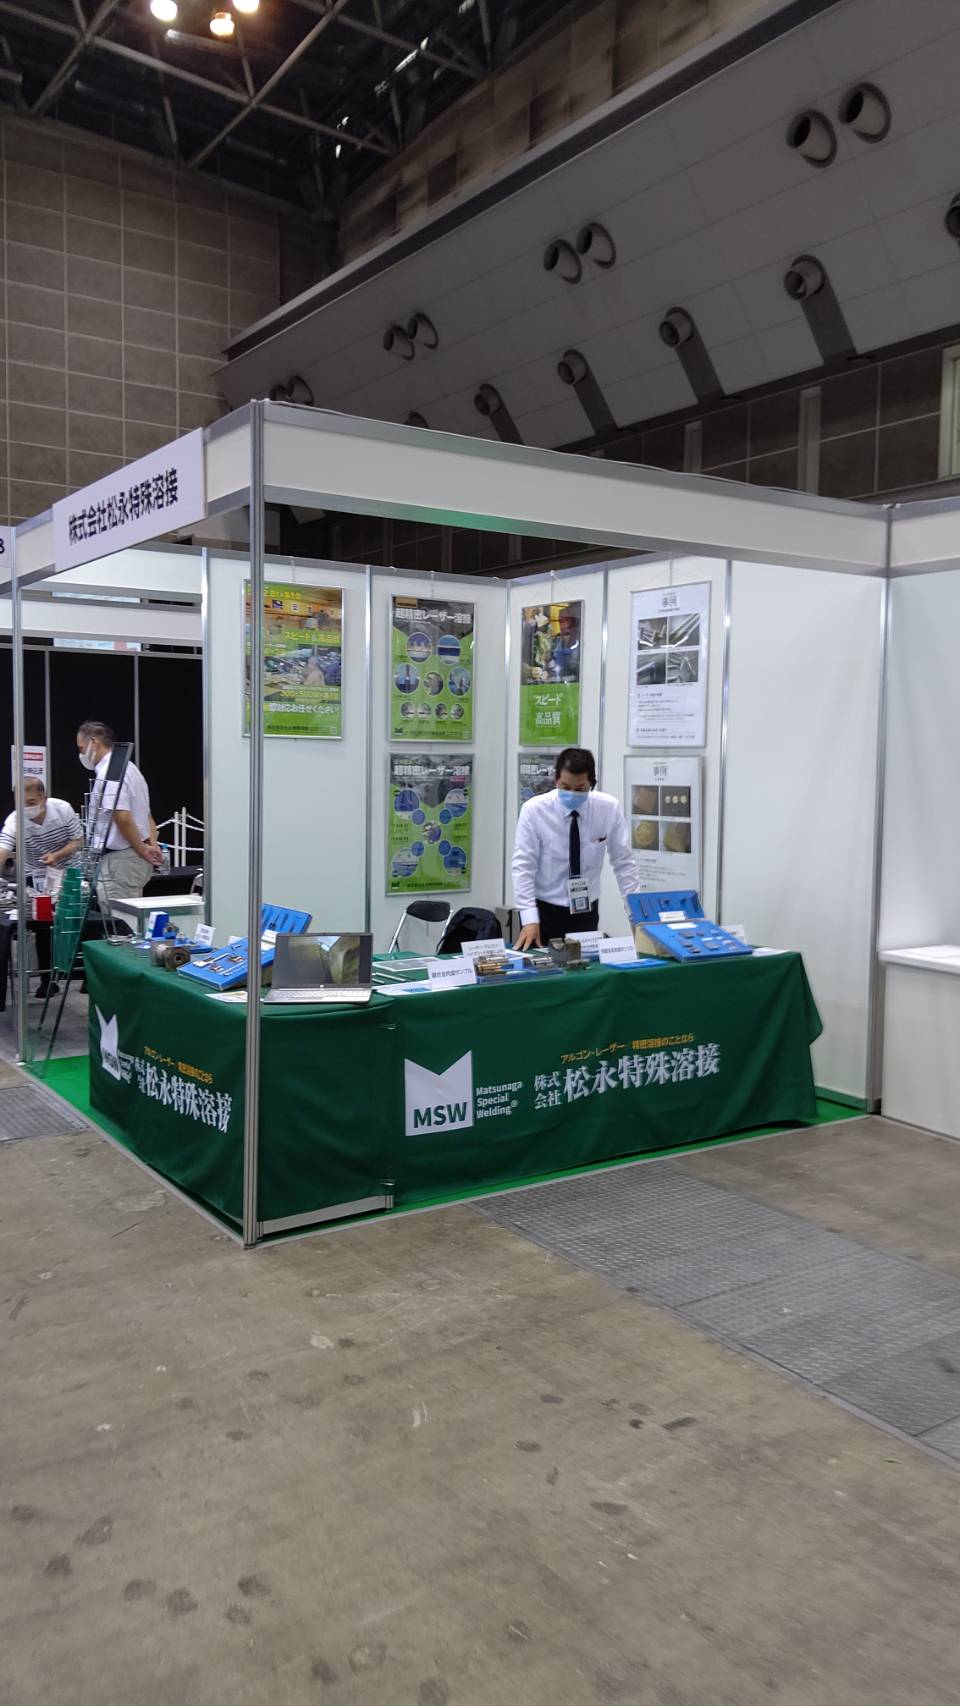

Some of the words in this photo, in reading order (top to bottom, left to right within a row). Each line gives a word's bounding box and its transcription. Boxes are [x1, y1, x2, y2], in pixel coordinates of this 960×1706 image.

[68, 467, 178, 545] 株式会社松永特殊溶接
[534, 692, 564, 706] スピード
[535, 710, 561, 726] 高品質
[534, 1071, 560, 1092] 株式
[563, 1042, 721, 1102] 松永特殊溶接
[145, 1063, 232, 1133] 松永特殊溶接
[476, 1081, 523, 1096] Matsunaga
[476, 1093, 509, 1108] Special
[534, 1090, 562, 1110] 会社
[413, 1102, 468, 1129] MSW
